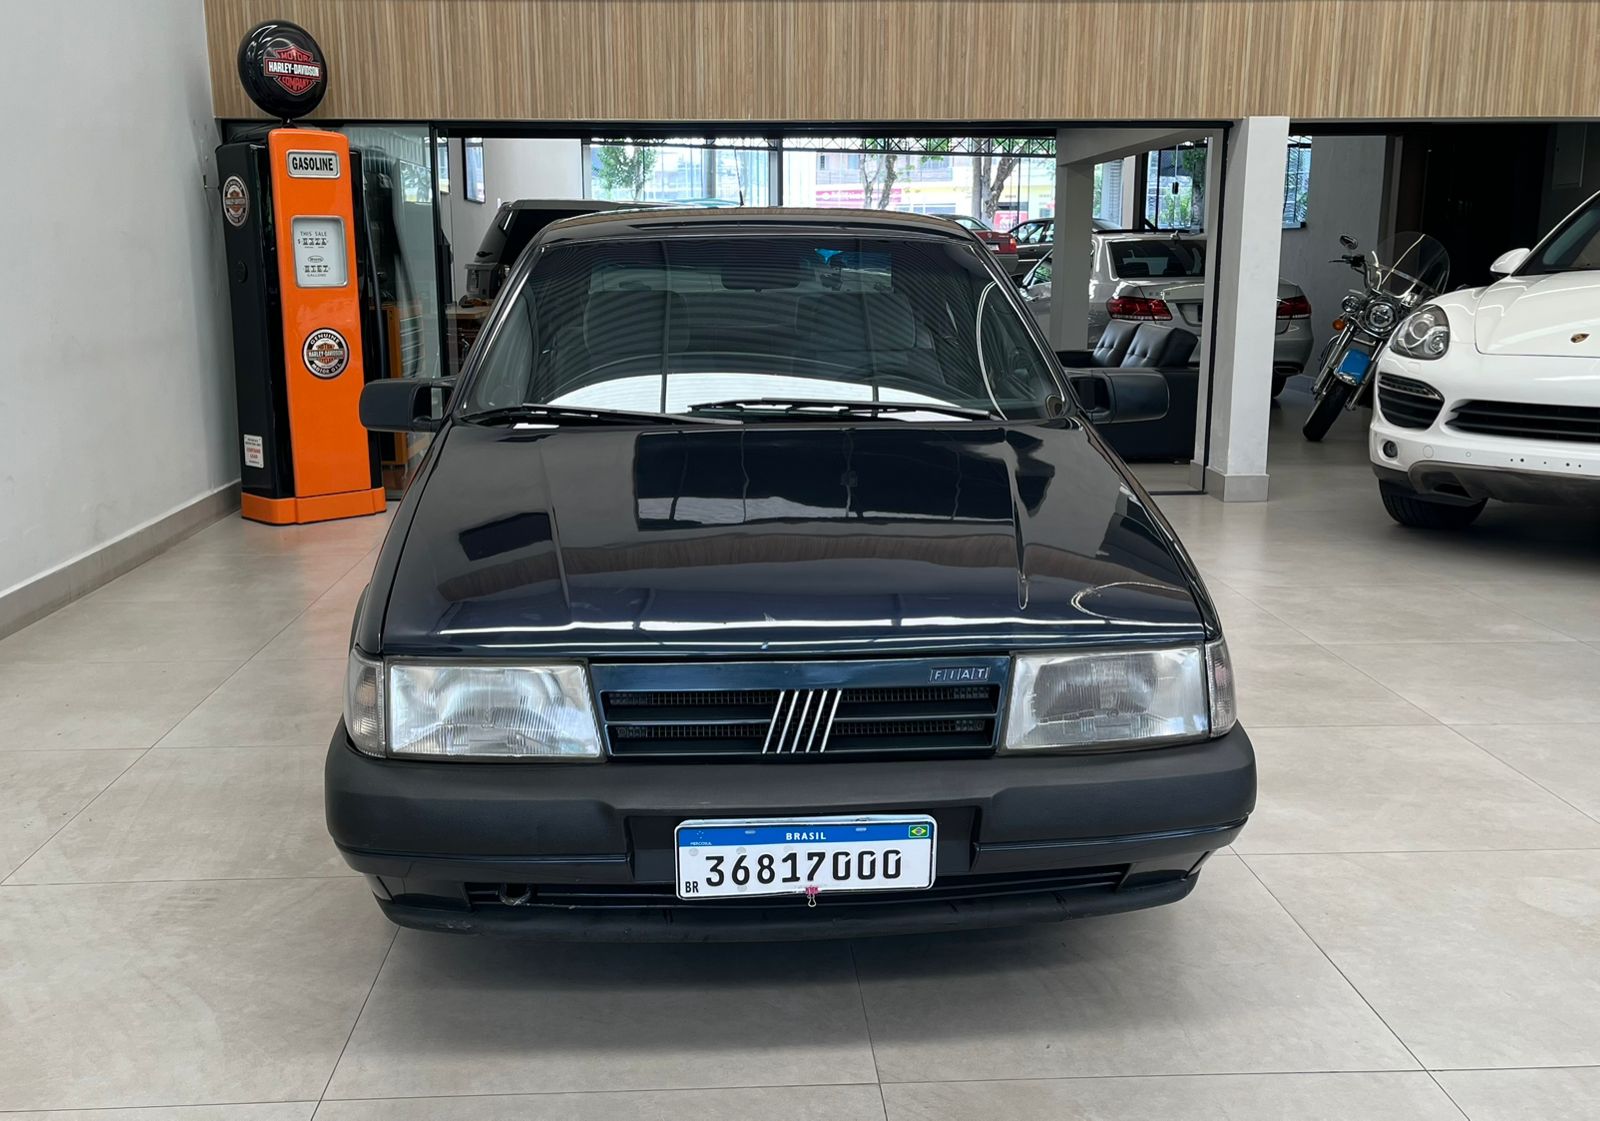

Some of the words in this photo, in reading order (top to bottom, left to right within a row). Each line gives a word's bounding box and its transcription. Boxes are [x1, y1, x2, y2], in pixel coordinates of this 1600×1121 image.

[281, 51, 309, 61] MOTOR
[268, 61, 320, 77] HARLEY-DAVIDSON
[282, 76, 310, 91] COMPANY
[291, 156, 334, 171] GASOLINE
[310, 333, 340, 345] GENUINE
[934, 667, 985, 680] FIAT
[785, 831, 827, 841] BRASIL
[705, 849, 902, 887] 36817000
[684, 880, 699, 894] BR
